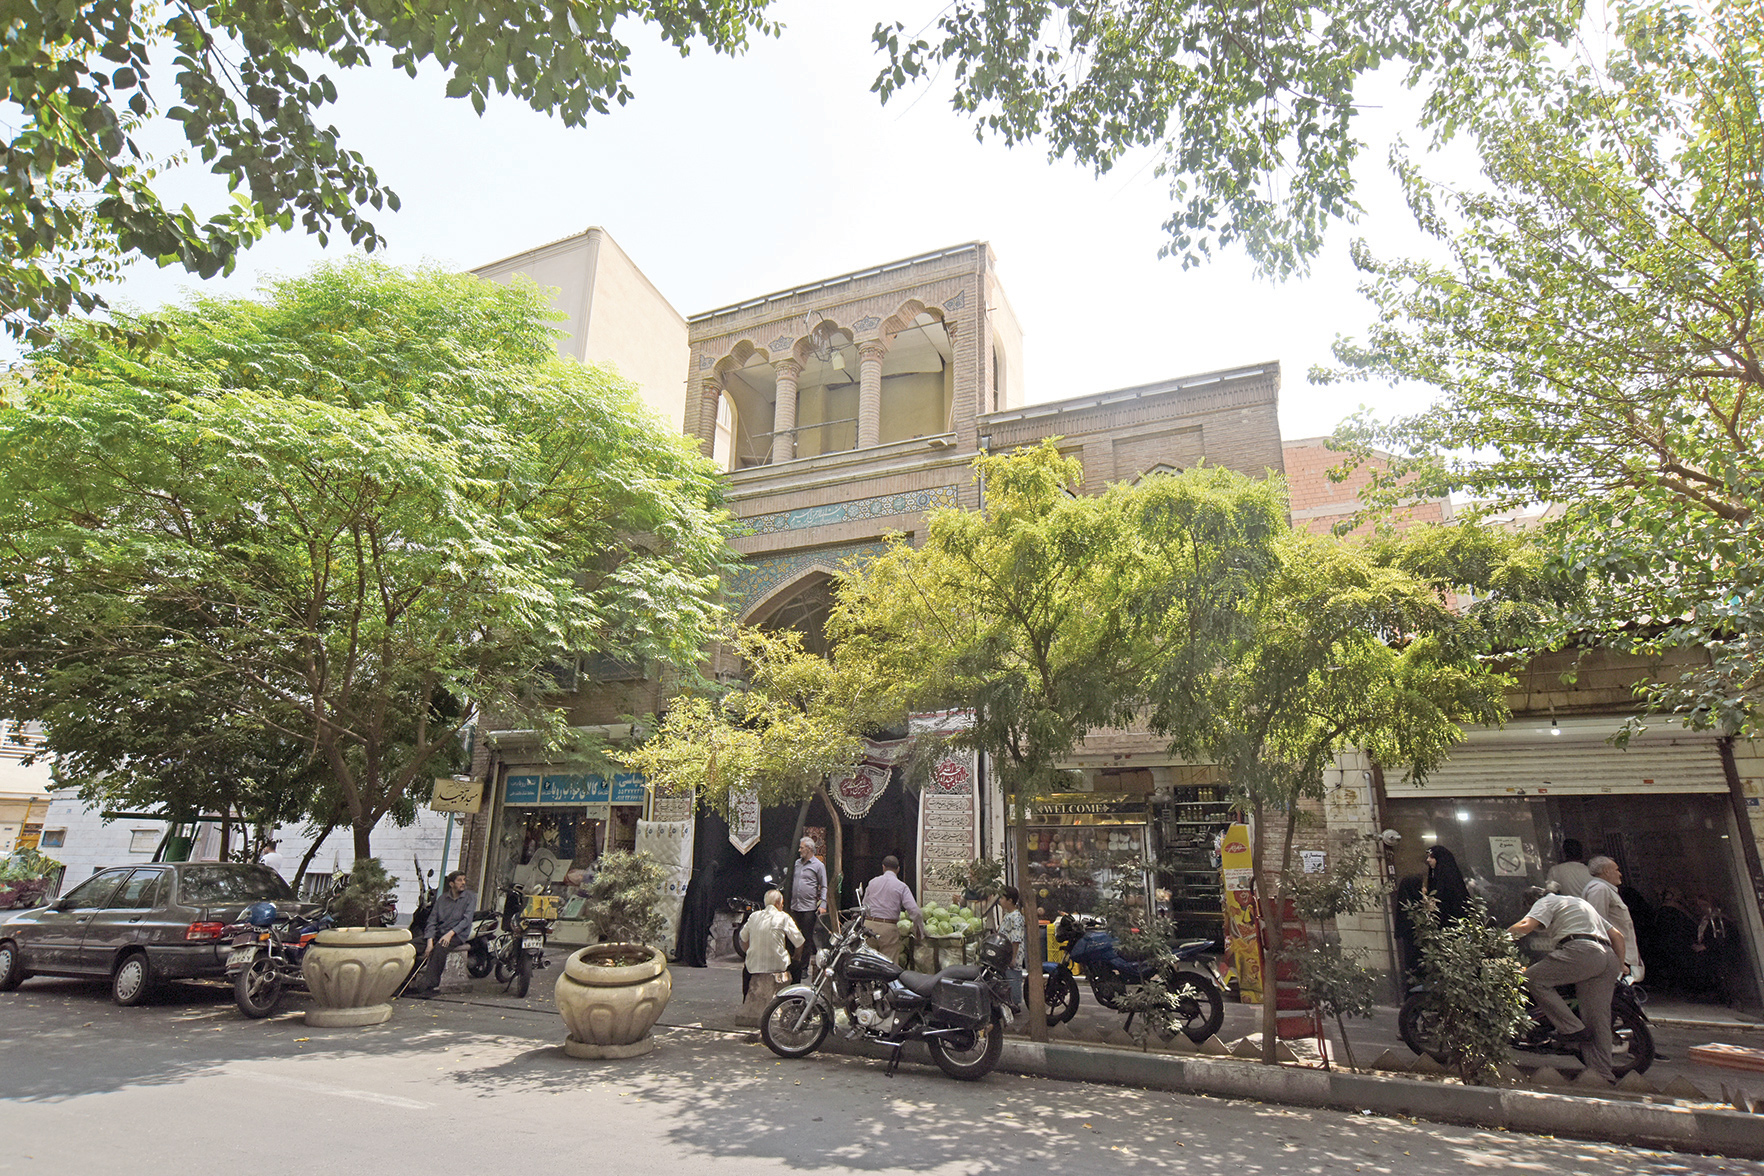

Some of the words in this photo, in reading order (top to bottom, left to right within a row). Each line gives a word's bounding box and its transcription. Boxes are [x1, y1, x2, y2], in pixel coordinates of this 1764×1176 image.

[437, 789, 470, 804] توحید
[551, 781, 563, 800] رویا
[563, 781, 581, 800] خواب
[1044, 804, 1103, 814] WELCOME
